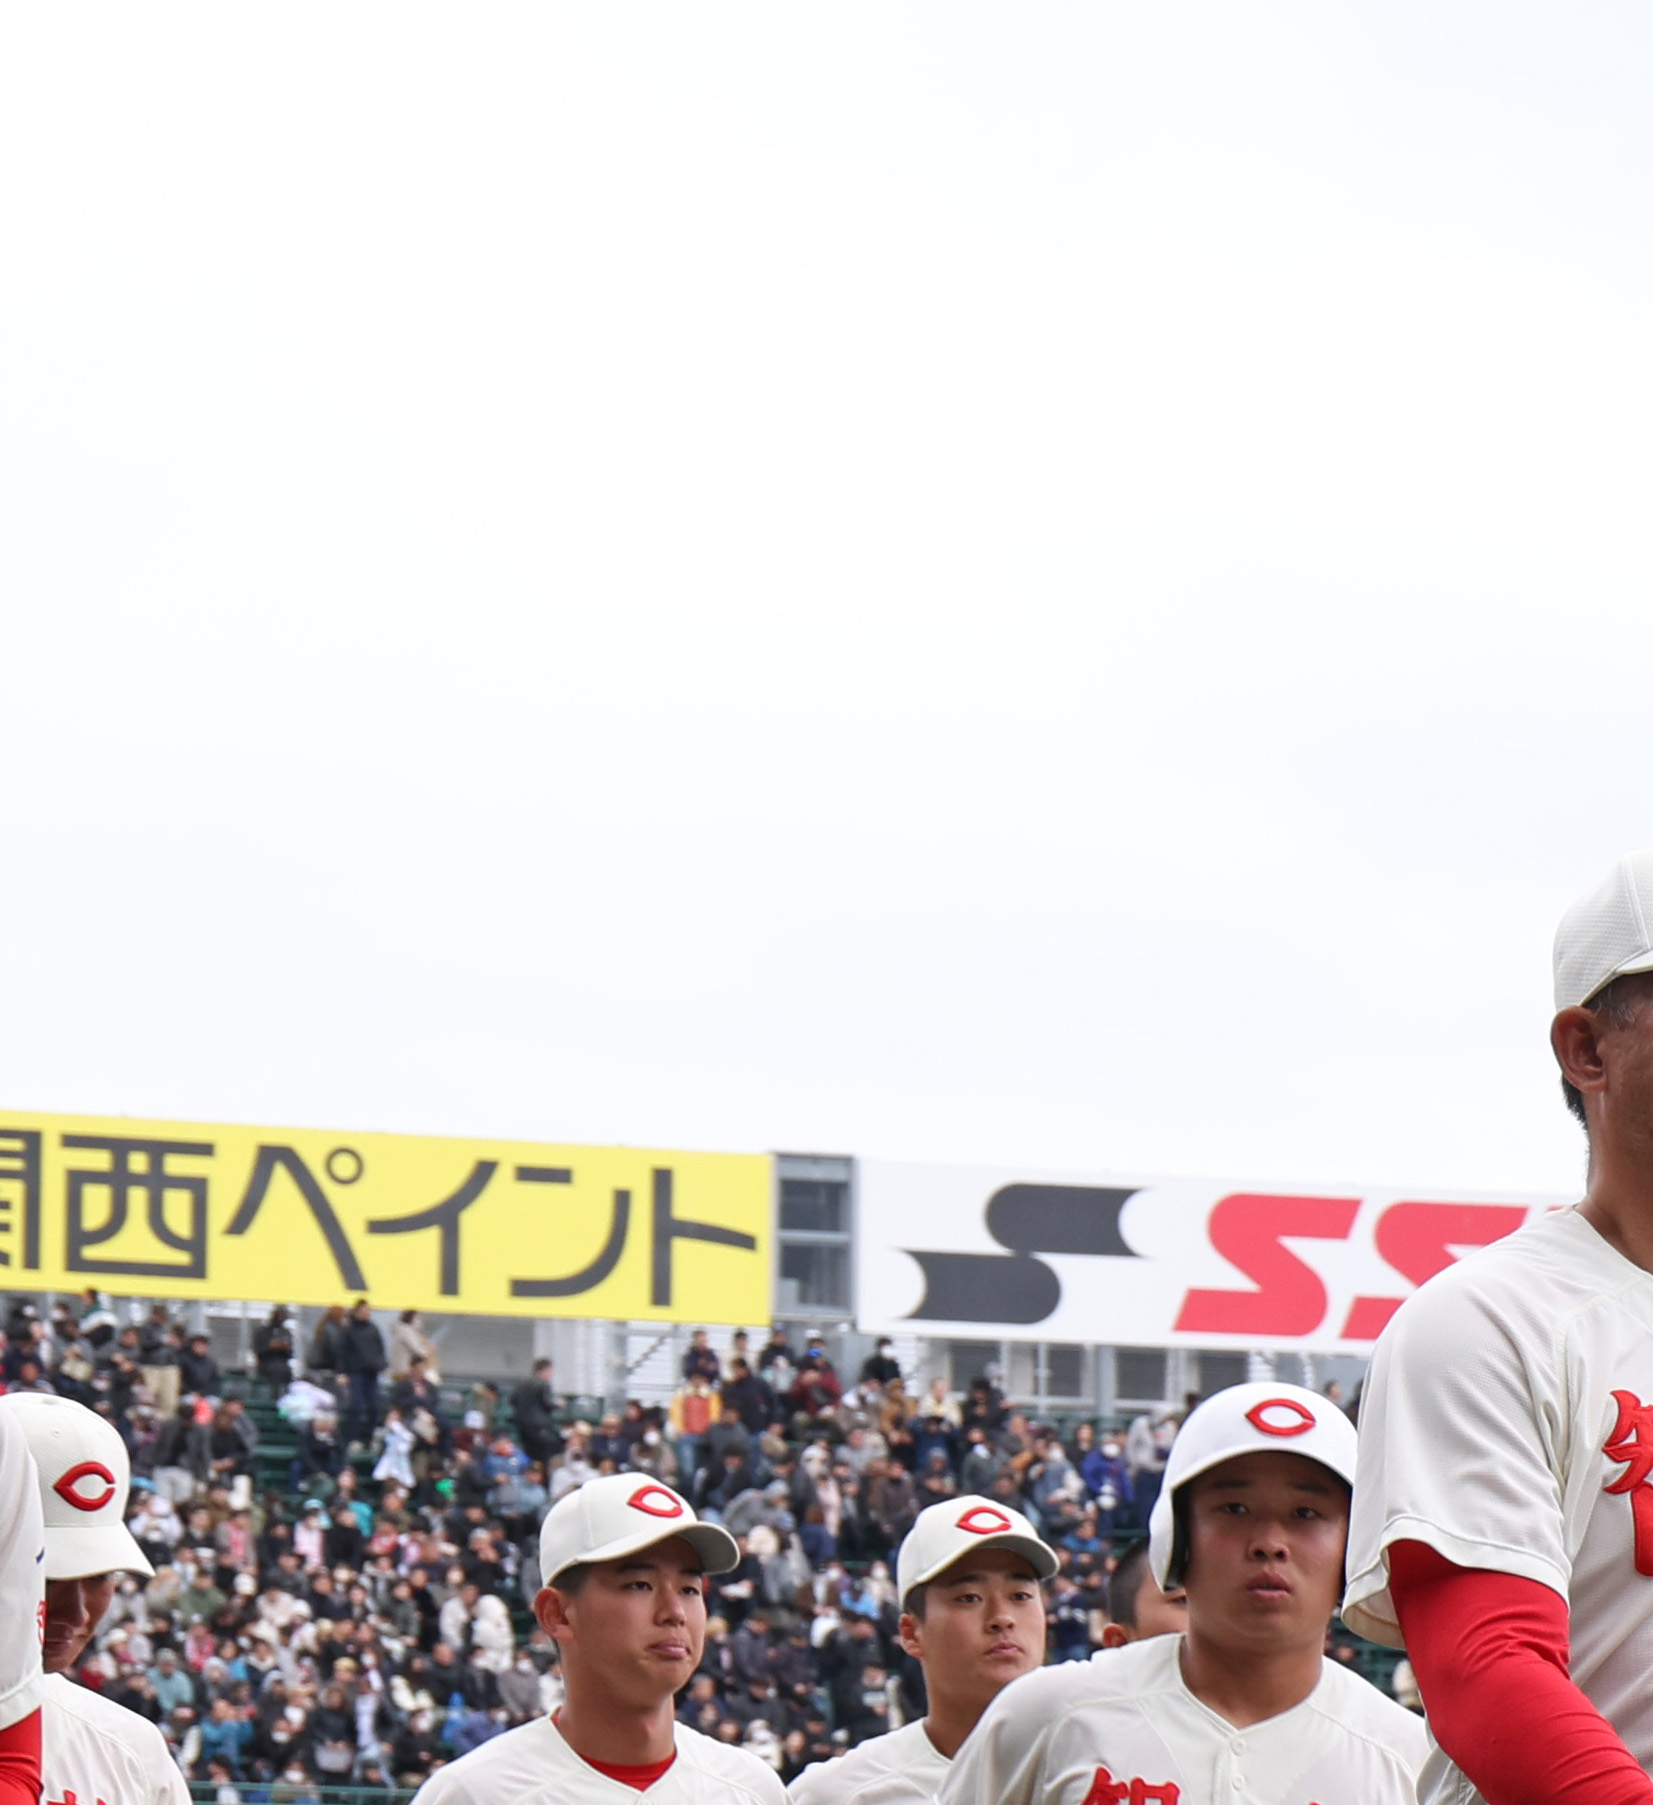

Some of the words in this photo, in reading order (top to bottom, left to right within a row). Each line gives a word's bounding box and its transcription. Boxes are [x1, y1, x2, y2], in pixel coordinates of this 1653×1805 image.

[0, 1129, 757, 1307] 西ペイント
[1173, 1194, 1565, 1340] SS
